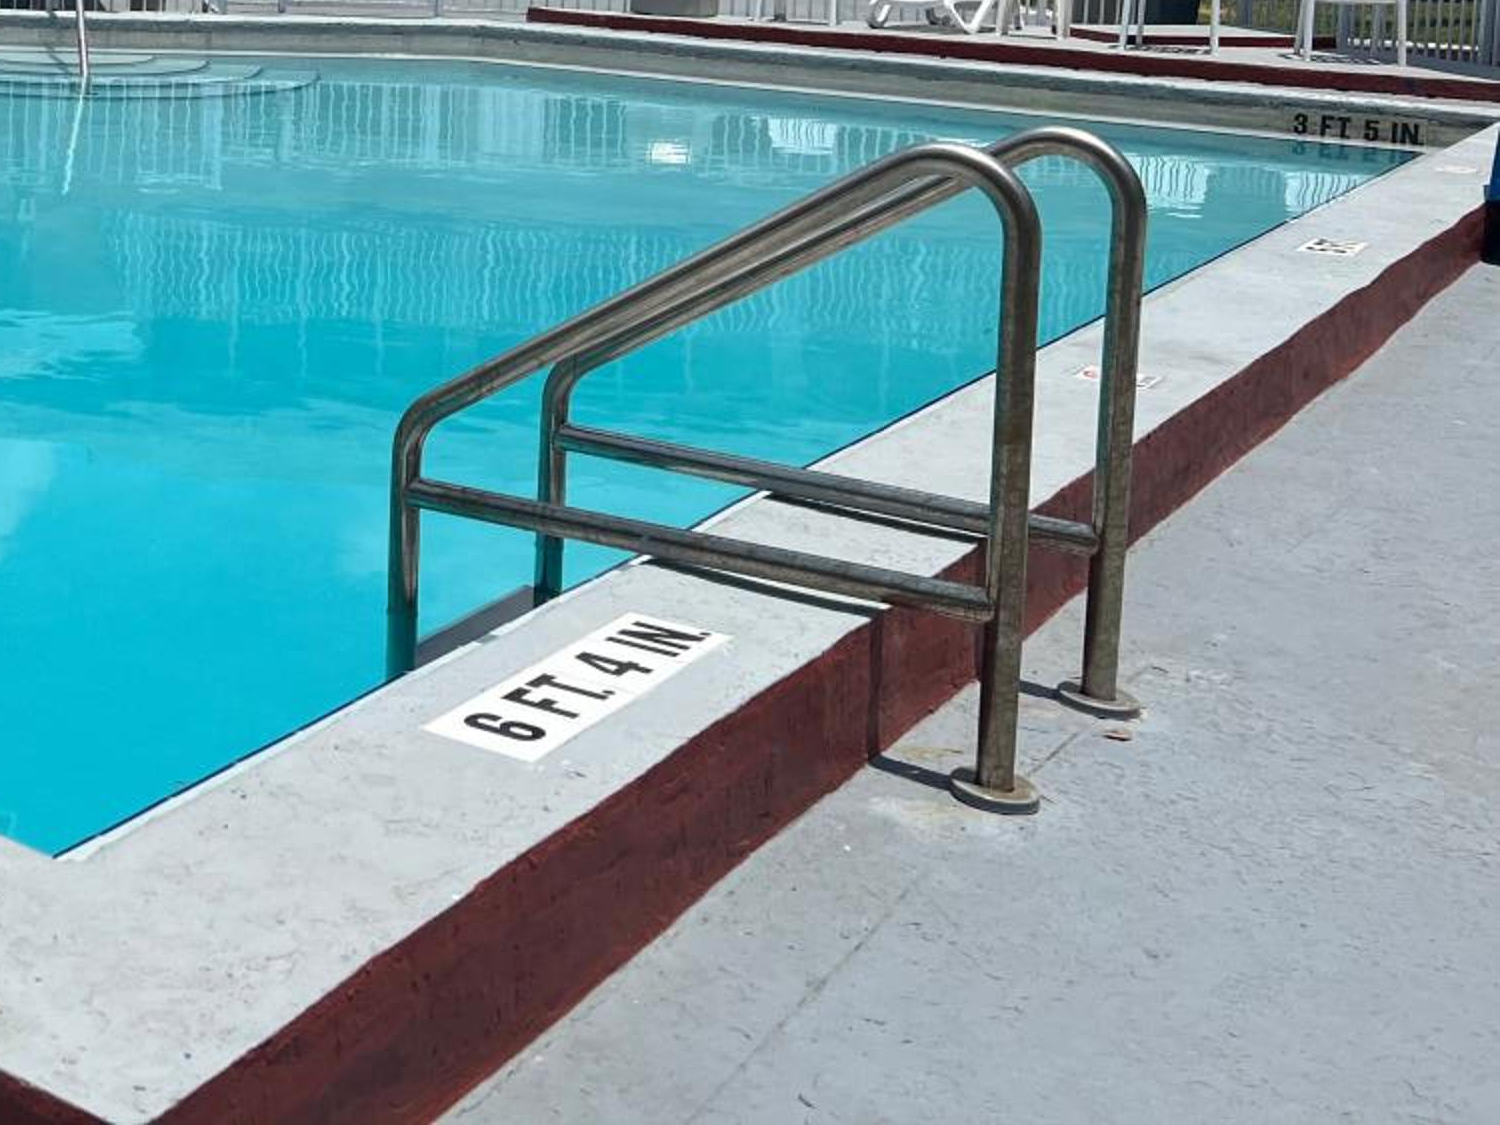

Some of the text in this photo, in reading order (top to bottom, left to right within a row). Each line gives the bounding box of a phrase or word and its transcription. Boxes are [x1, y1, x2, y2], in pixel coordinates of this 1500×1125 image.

[1293, 113, 1308, 134] 3
[1363, 119, 1379, 141] 5
[463, 712, 546, 742] 6
[575, 652, 654, 677] 4
